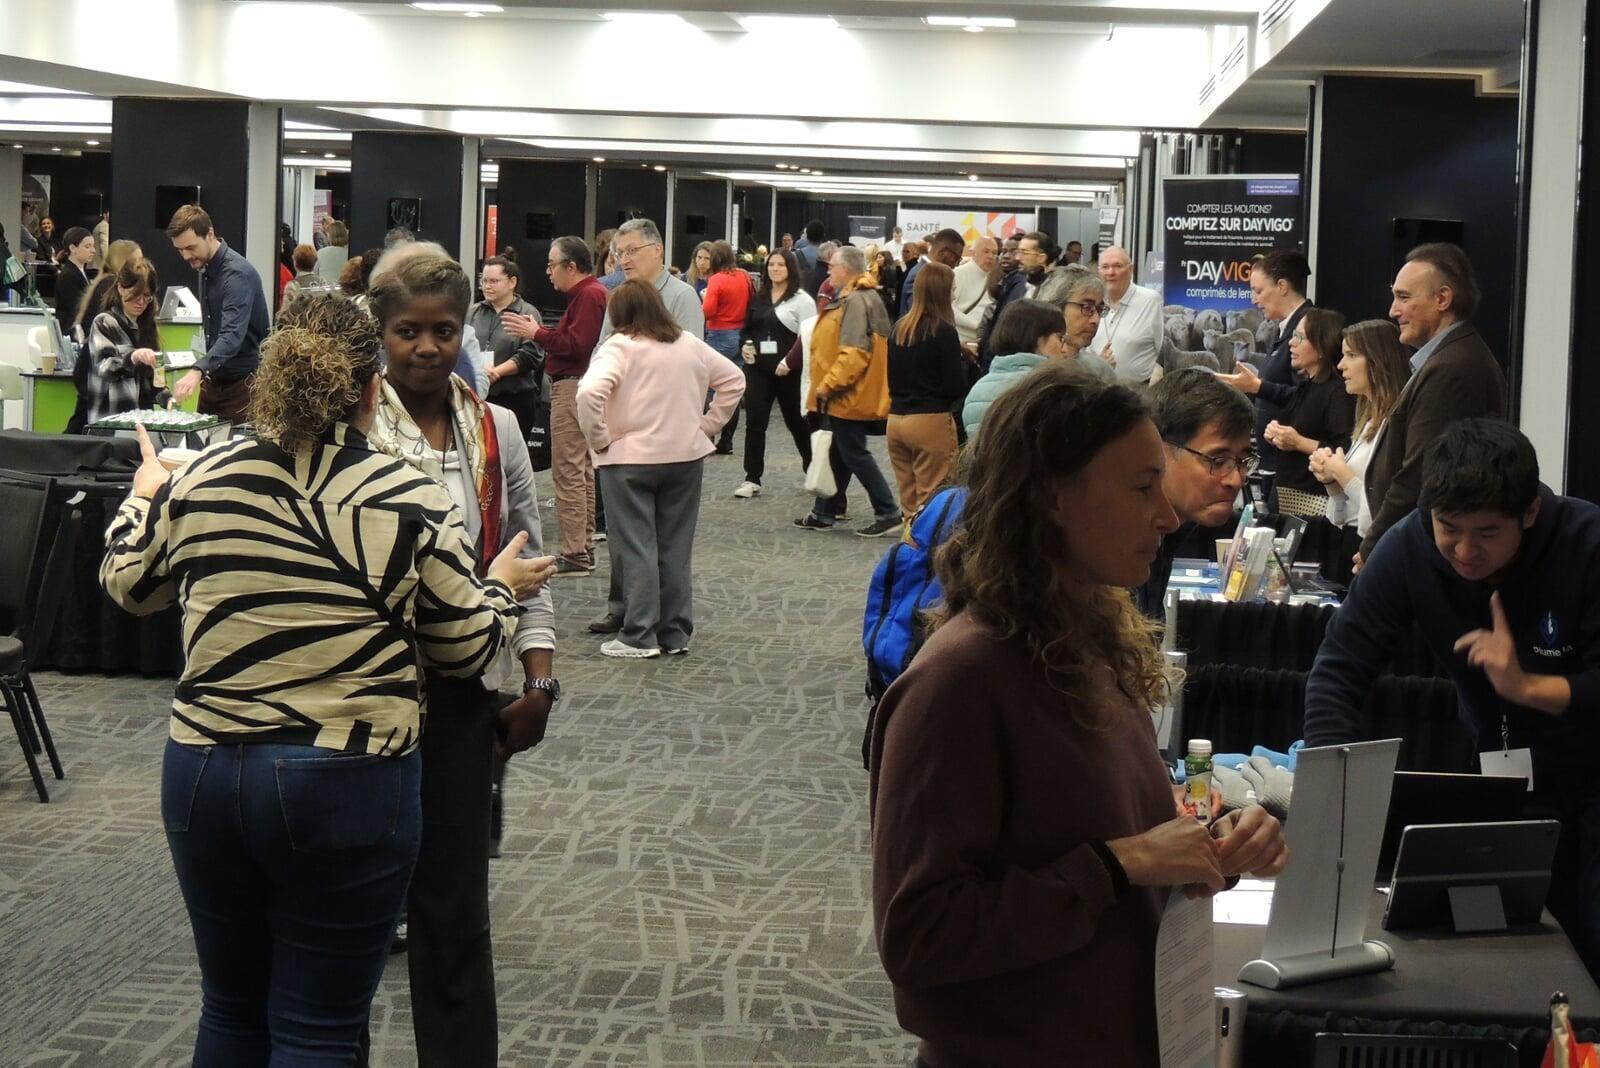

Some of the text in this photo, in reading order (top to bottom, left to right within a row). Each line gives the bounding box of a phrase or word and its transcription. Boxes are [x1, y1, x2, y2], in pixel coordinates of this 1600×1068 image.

[1187, 204, 1272, 214] COMPTER LES MOUTONS?
[1166, 217, 1218, 230] COMPTEZ
[1219, 217, 1241, 231] SUR
[1186, 286, 1252, 300] comprimés de lem
